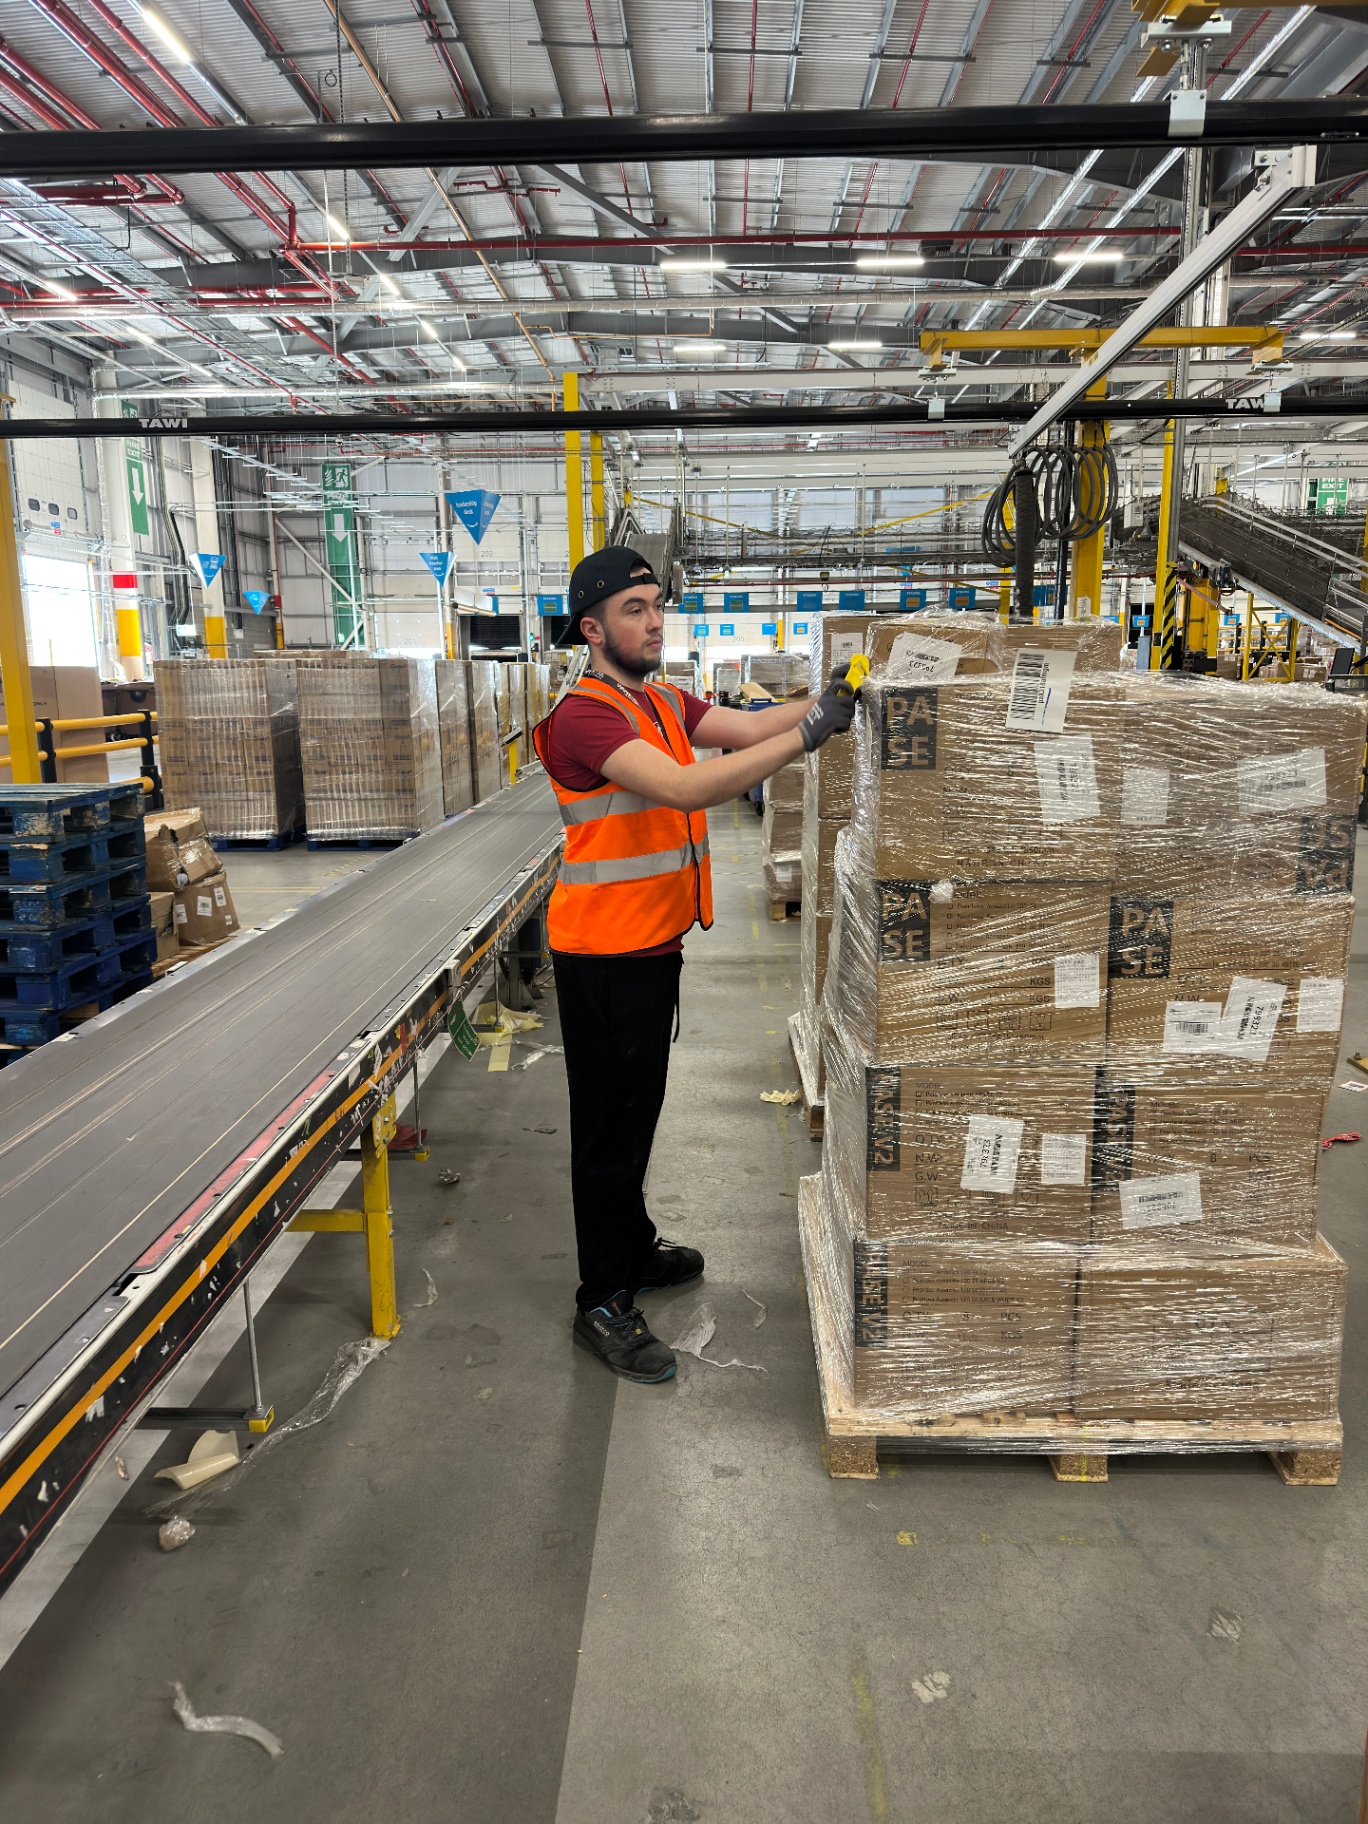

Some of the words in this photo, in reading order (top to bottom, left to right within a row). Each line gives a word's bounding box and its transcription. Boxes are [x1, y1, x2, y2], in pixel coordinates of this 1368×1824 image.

[1225, 398, 1264, 410] TAW
[139, 418, 188, 429] TAWI
[127, 447, 141, 458] EXIT
[480, 550, 494, 558] 202
[886, 695, 934, 729] PA
[887, 736, 929, 767] SE
[882, 892, 928, 921] PA
[1122, 906, 1168, 938] PA
[883, 929, 924, 958] SE
[1121, 946, 1164, 976] SE
[1030, 977, 1051, 986] KGS
[1029, 995, 1051, 1003] KGS
[1209, 1153, 1217, 1163] 8
[981, 1221, 1009, 1230] CHINA
[1000, 1311, 1022, 1321] PCS
